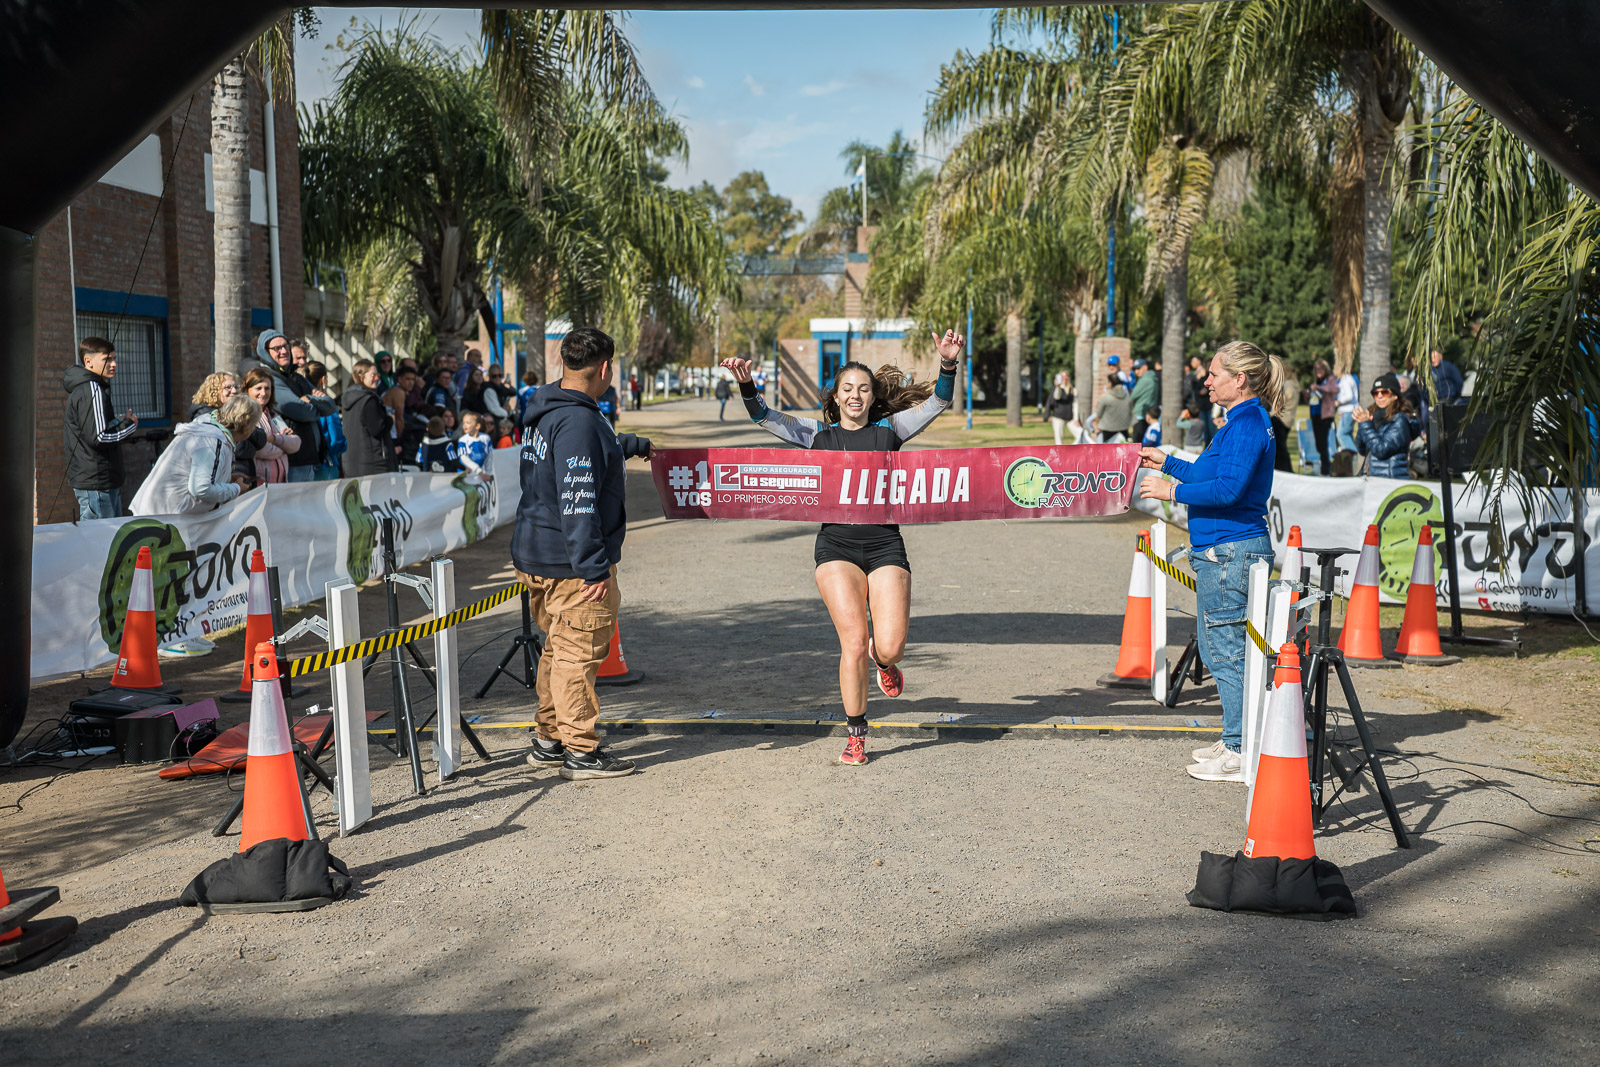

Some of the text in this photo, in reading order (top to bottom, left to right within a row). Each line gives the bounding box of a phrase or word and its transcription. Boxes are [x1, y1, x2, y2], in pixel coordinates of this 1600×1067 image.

[668, 460, 711, 490] #1
[743, 466, 818, 475] GRUPO ASEGURADOR
[759, 476, 818, 490] segunda
[839, 467, 970, 505] LLEGADA
[674, 491, 712, 507] VOS
[717, 494, 819, 506] LO PRIMERO SOS VOS
[1038, 496, 1074, 508] RAV
[1489, 581, 1557, 599] @cronorav
